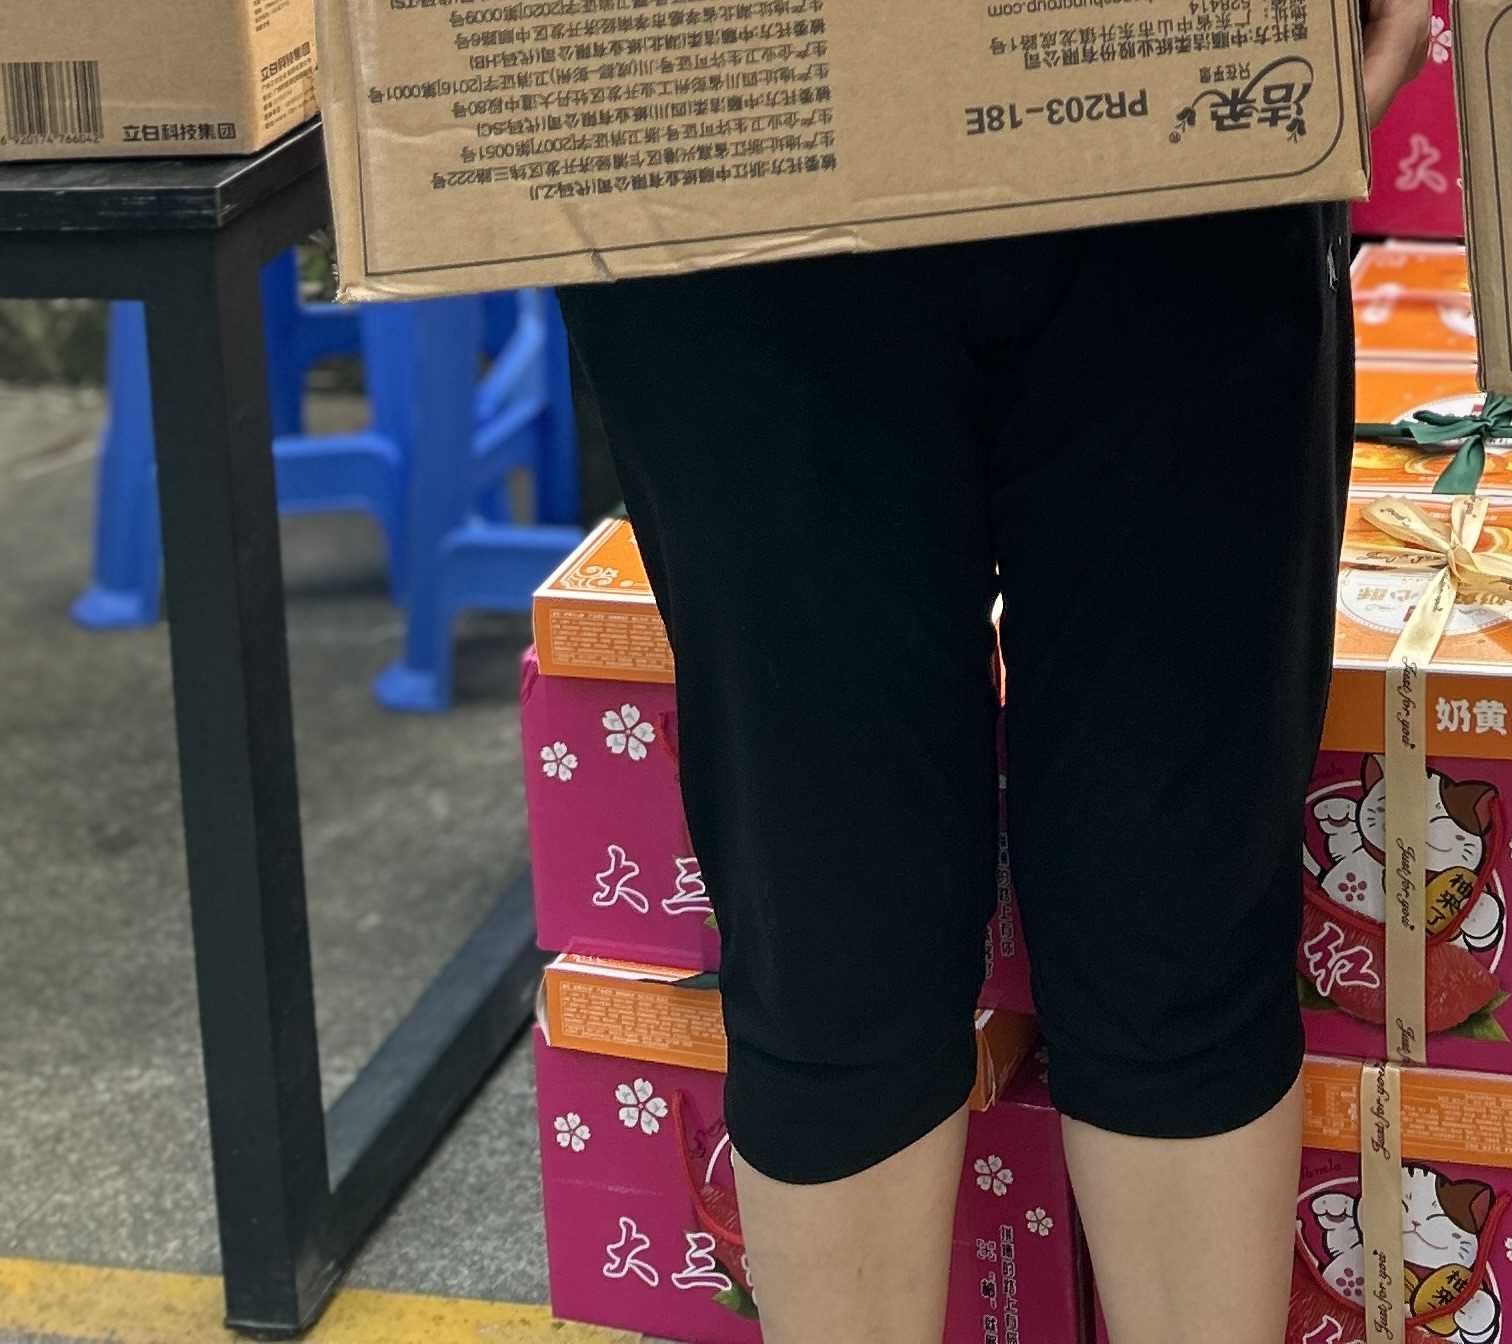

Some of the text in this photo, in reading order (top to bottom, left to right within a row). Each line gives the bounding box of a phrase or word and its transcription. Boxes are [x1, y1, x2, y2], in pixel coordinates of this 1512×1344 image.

[966, 88, 1149, 136] PR203-18E
[122, 123, 236, 143] 立白科技集团
[1401, 657, 1418, 693] Just
[1397, 689, 1418, 717] for
[1396, 838, 1418, 879] Just
[1303, 921, 1381, 997] 红
[1372, 1280, 1392, 1307] for
[1374, 1304, 1395, 1340] Just
